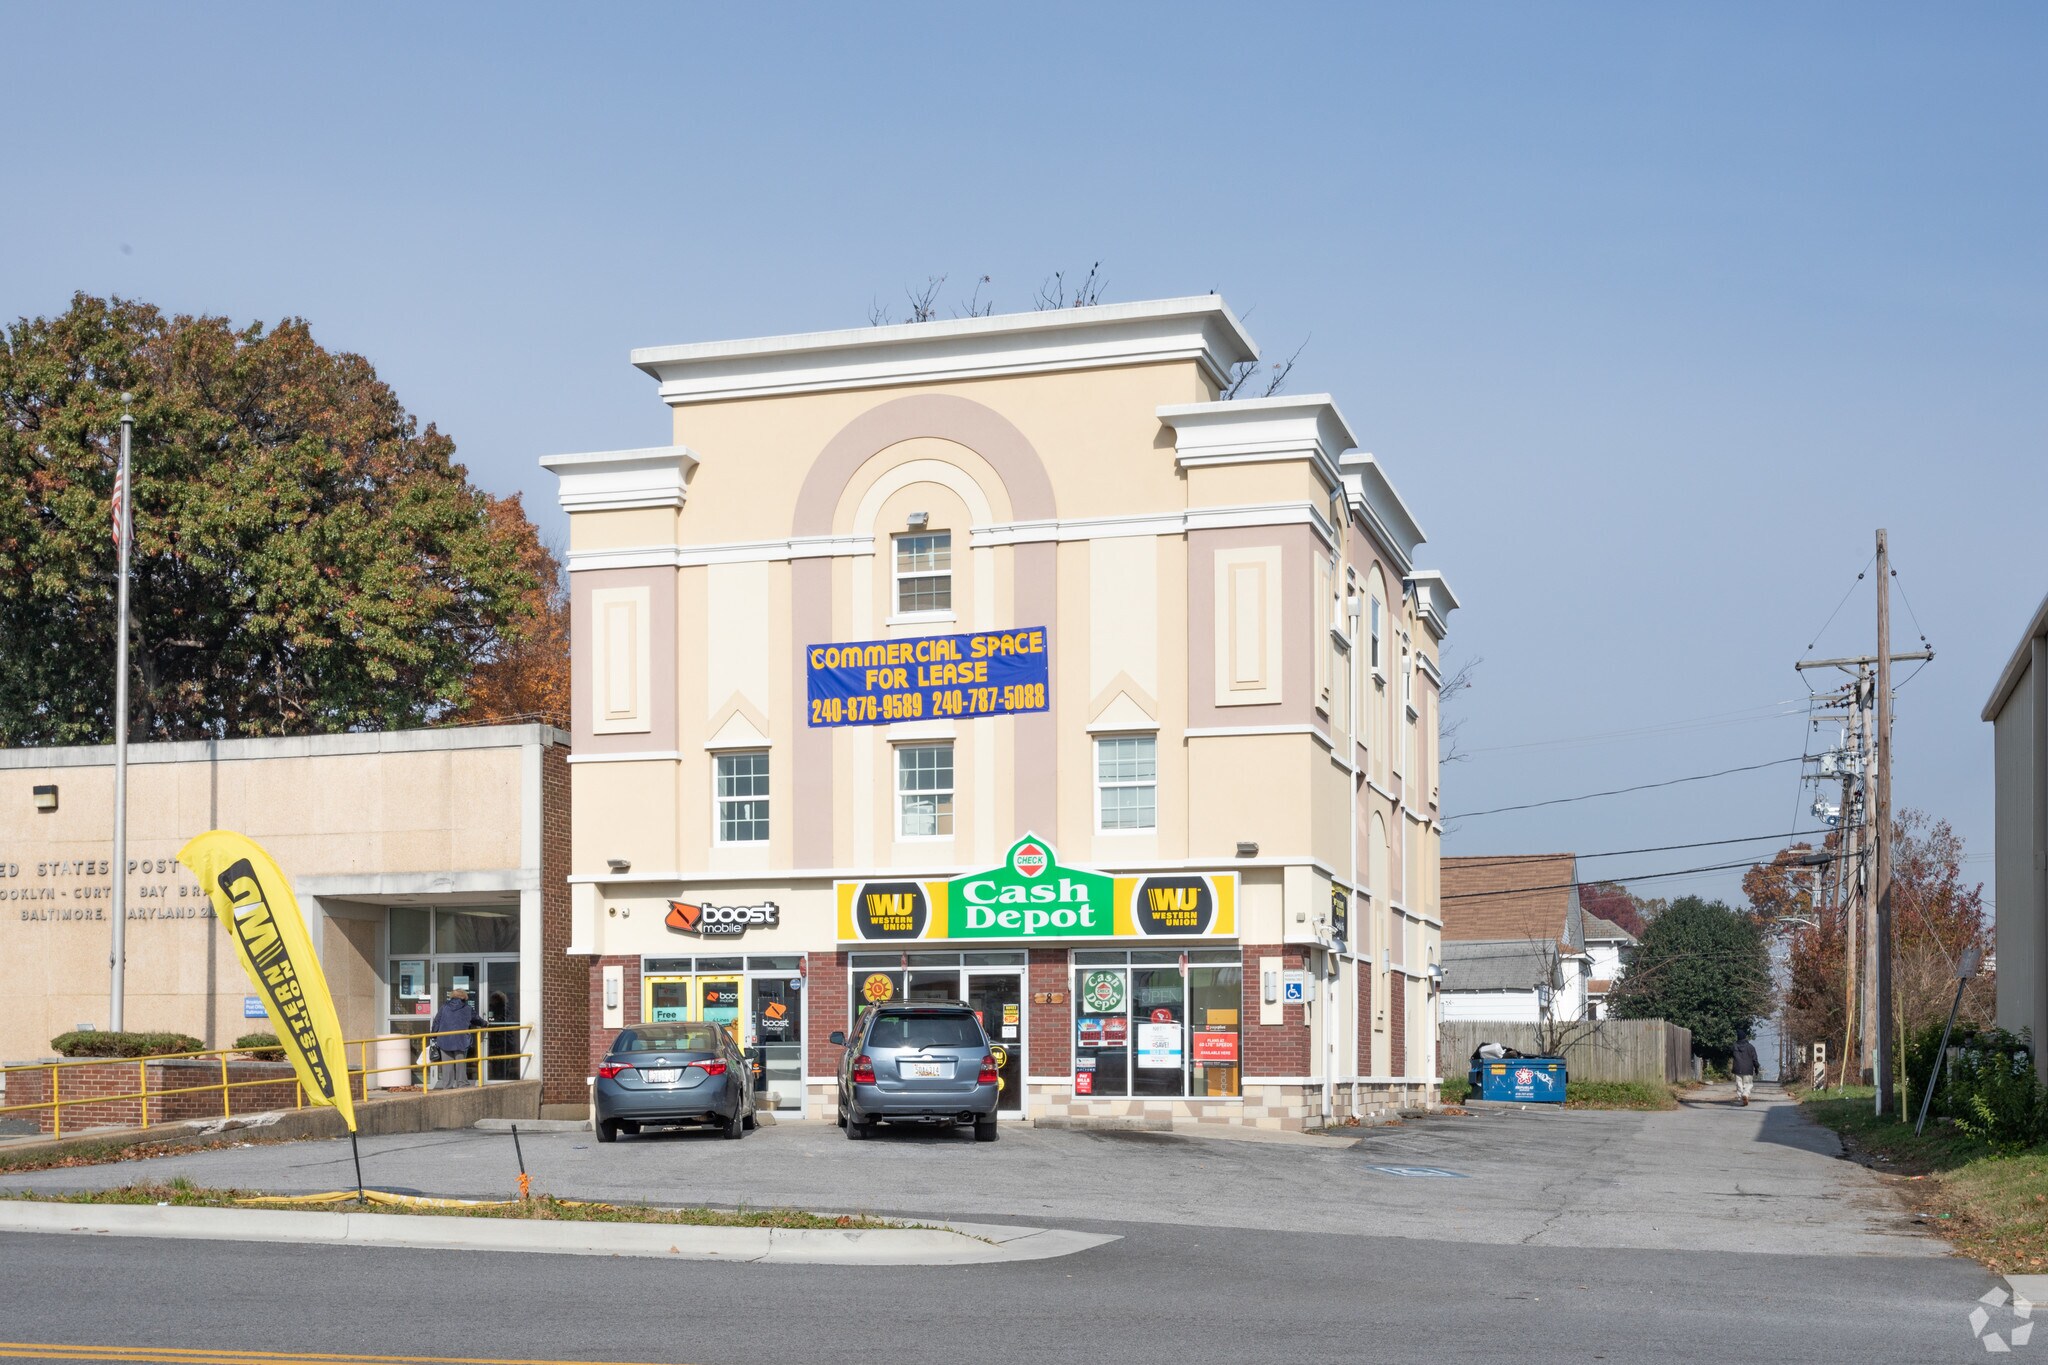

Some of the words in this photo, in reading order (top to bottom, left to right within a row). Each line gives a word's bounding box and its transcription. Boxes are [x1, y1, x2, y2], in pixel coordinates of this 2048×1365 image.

[811, 639, 962, 670] COMMERCIAL
[971, 631, 1043, 658] SPACE
[866, 668, 909, 690] FOR
[918, 661, 988, 687] LEASE
[812, 692, 922, 723] 240-876-9589
[932, 683, 1045, 716] 240-787-5088
[37, 859, 109, 876] STATES
[127, 858, 179, 875] POST
[1017, 855, 1043, 865] CHECK
[74, 886, 111, 899] CURT
[140, 885, 167, 898] BAY
[963, 878, 1090, 905] Cash
[1150, 887, 1198, 911] WU
[20, 907, 107, 922] BALTIMORE,
[127, 906, 195, 920] ARYLAND
[702, 902, 775, 924] boost
[870, 893, 914, 917] WU
[965, 904, 1096, 934] Depot
[1152, 911, 1198, 919] WESTERN
[703, 923, 741, 933] mobile
[883, 923, 913, 931] UNION
[1088, 974, 1120, 987] Cash
[279, 958, 317, 1045] UNION
[1086, 992, 1121, 1011] Depot
[1141, 988, 1179, 1004] OPEN
[657, 1010, 677, 1019] Free
[762, 1018, 789, 1027] boost
[262, 965, 328, 1090] WESTERN
